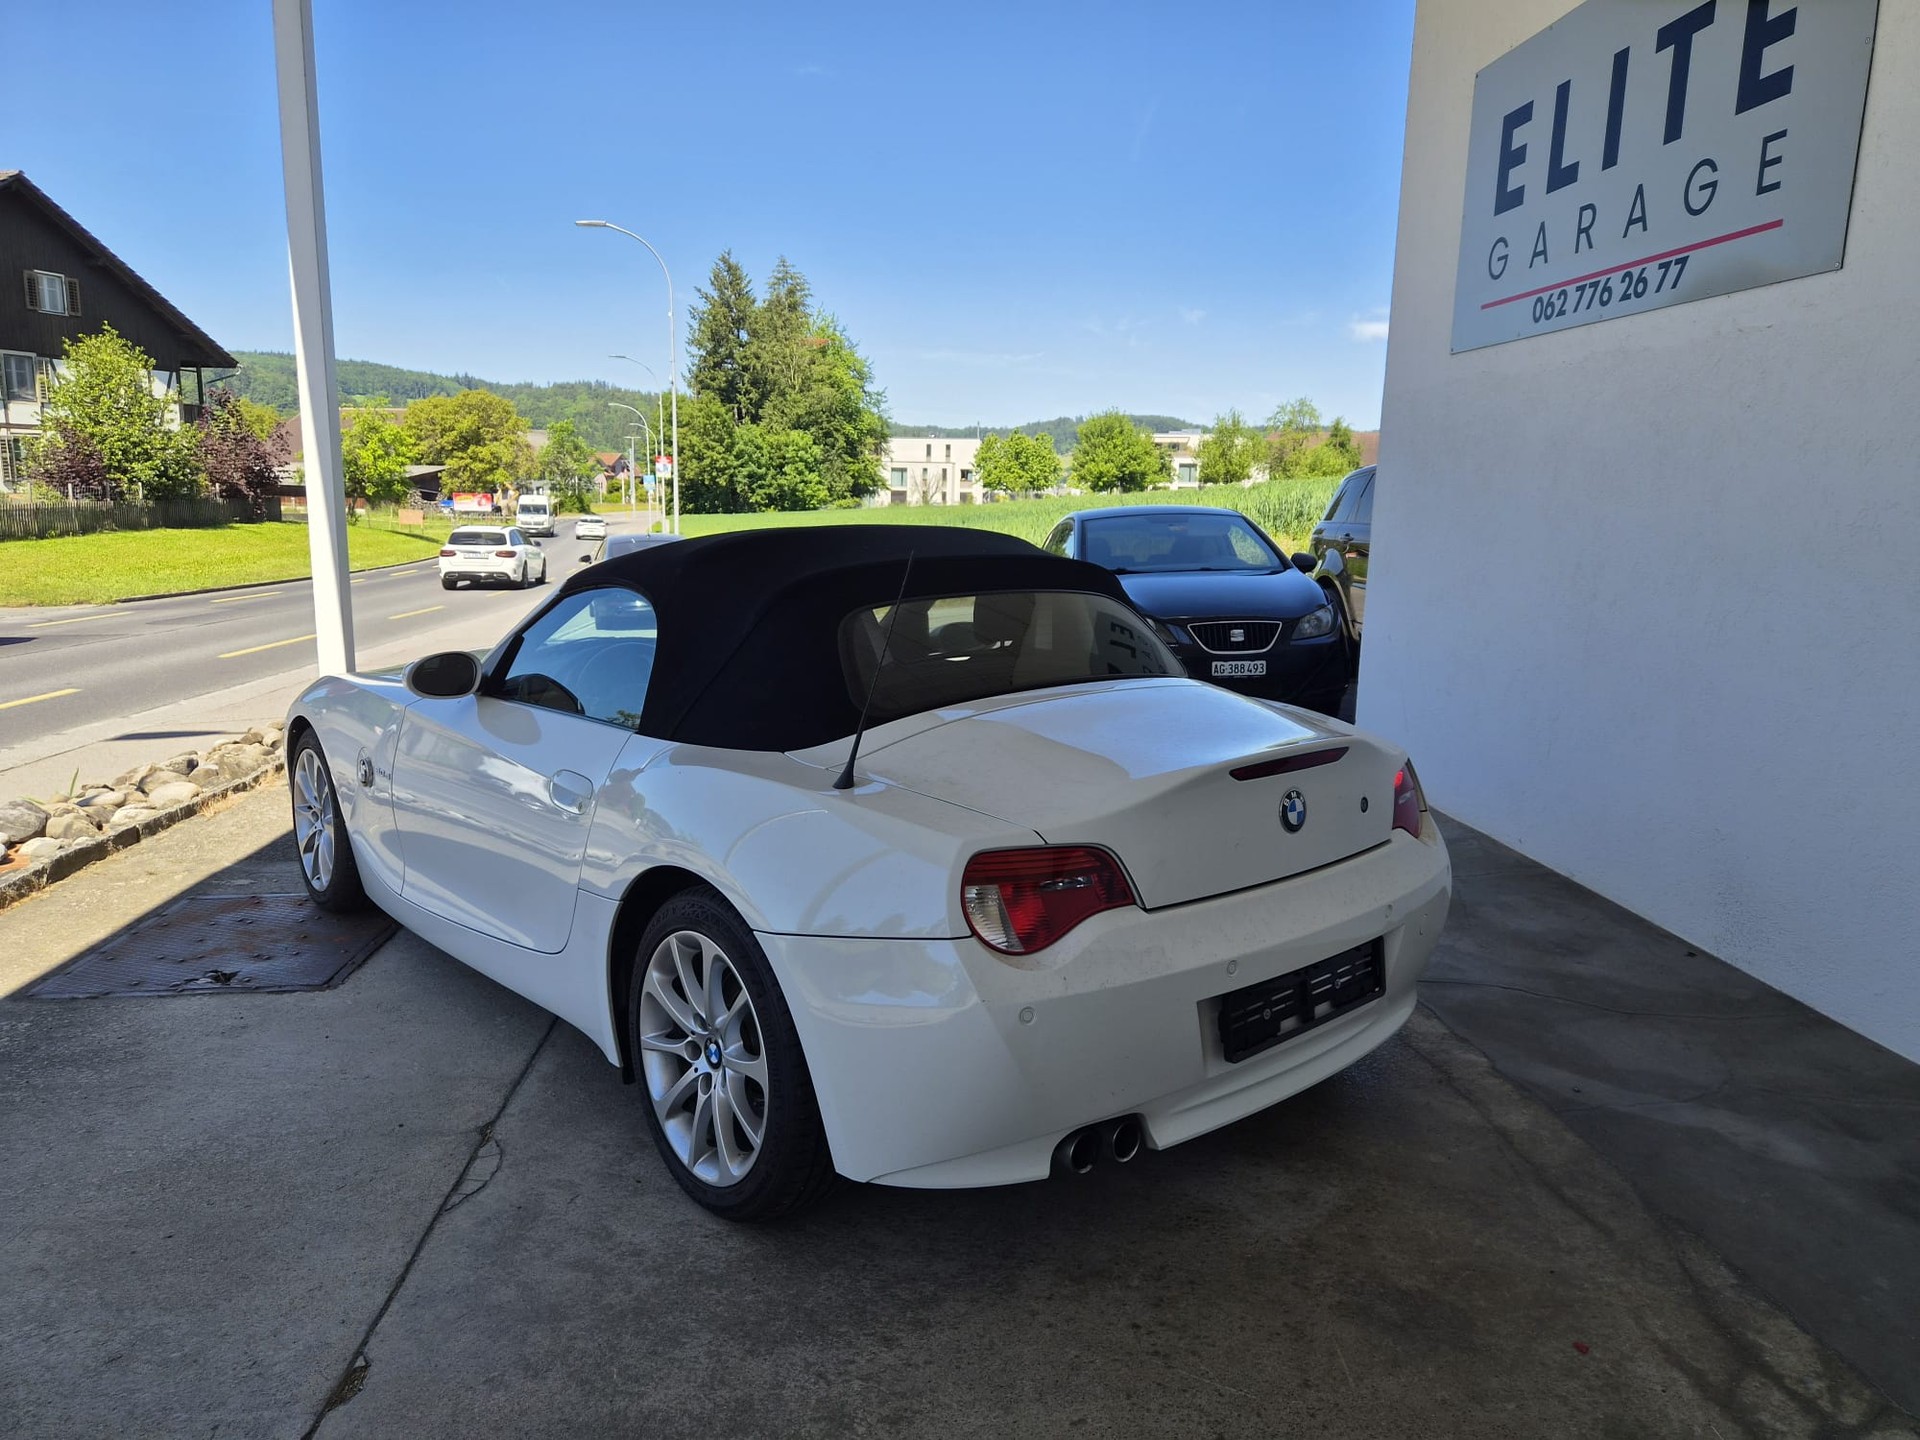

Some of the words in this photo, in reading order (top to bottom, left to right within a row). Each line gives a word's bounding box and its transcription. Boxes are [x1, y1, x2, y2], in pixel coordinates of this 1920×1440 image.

[1494, 0, 1798, 216] ELITE
[1488, 129, 1788, 280] GARAGE
[1532, 289, 1568, 323] 062
[1572, 276, 1613, 313] 776
[1618, 266, 1648, 302] 26
[1654, 255, 1690, 293] 77
